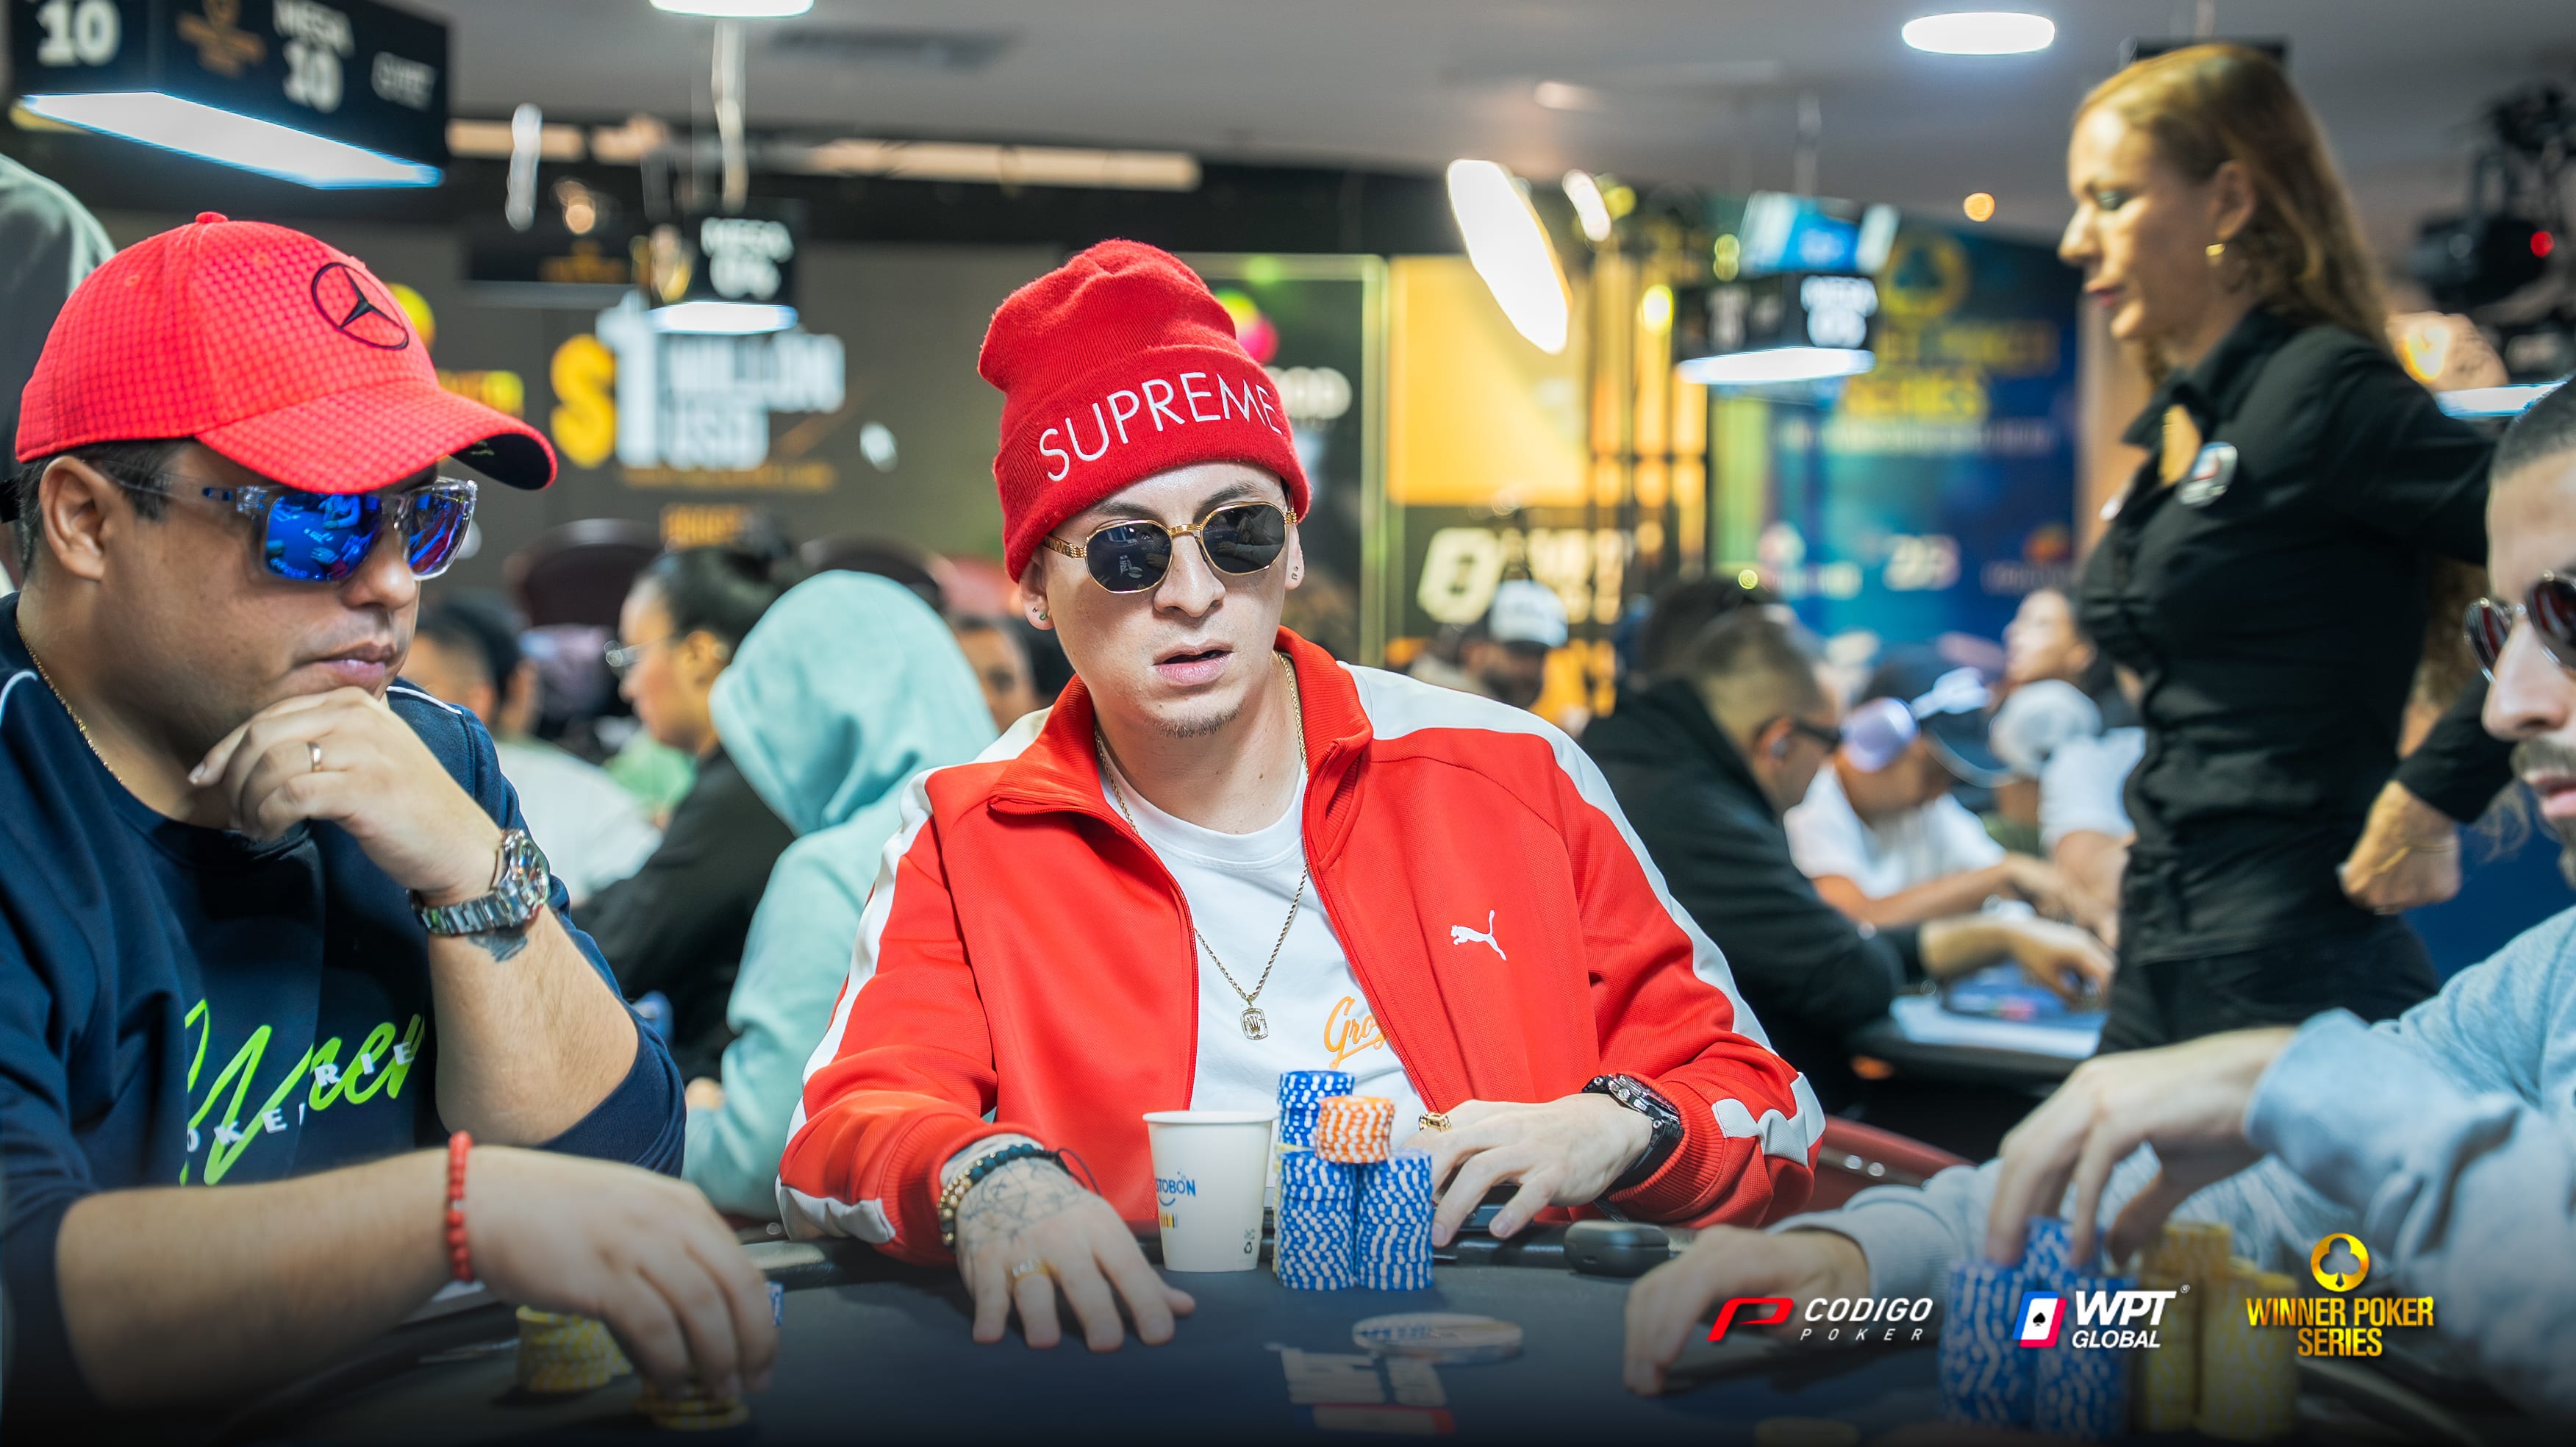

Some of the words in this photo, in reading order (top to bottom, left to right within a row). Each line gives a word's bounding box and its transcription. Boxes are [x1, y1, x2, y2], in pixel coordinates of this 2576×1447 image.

[37, 0, 121, 66] 10
[282, 39, 343, 112] 10
[1039, 371, 1283, 482] SUPREME
